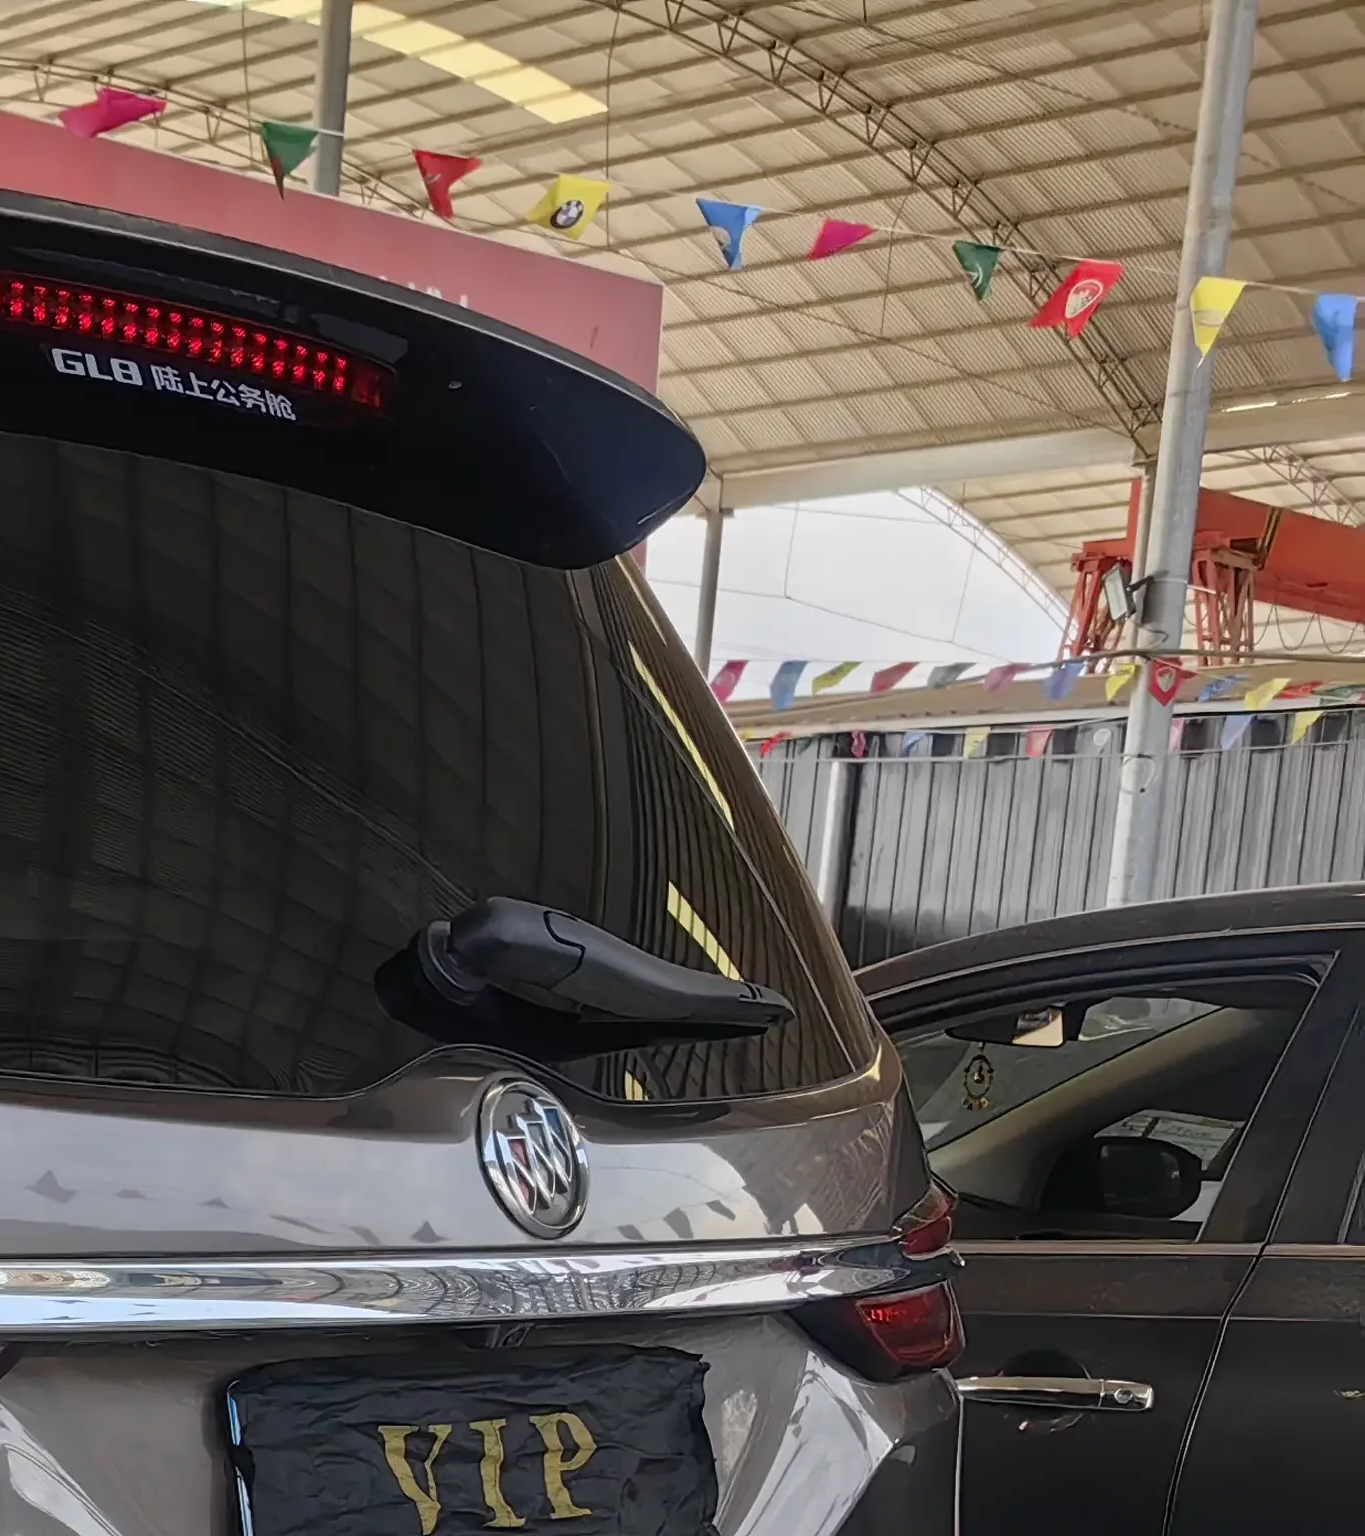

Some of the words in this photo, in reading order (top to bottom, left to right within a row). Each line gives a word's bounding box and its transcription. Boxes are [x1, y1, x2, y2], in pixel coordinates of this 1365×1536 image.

[52, 348, 143, 386] GL8
[150, 364, 296, 421] 陆上公务舱
[377, 1411, 598, 1536] VIP
